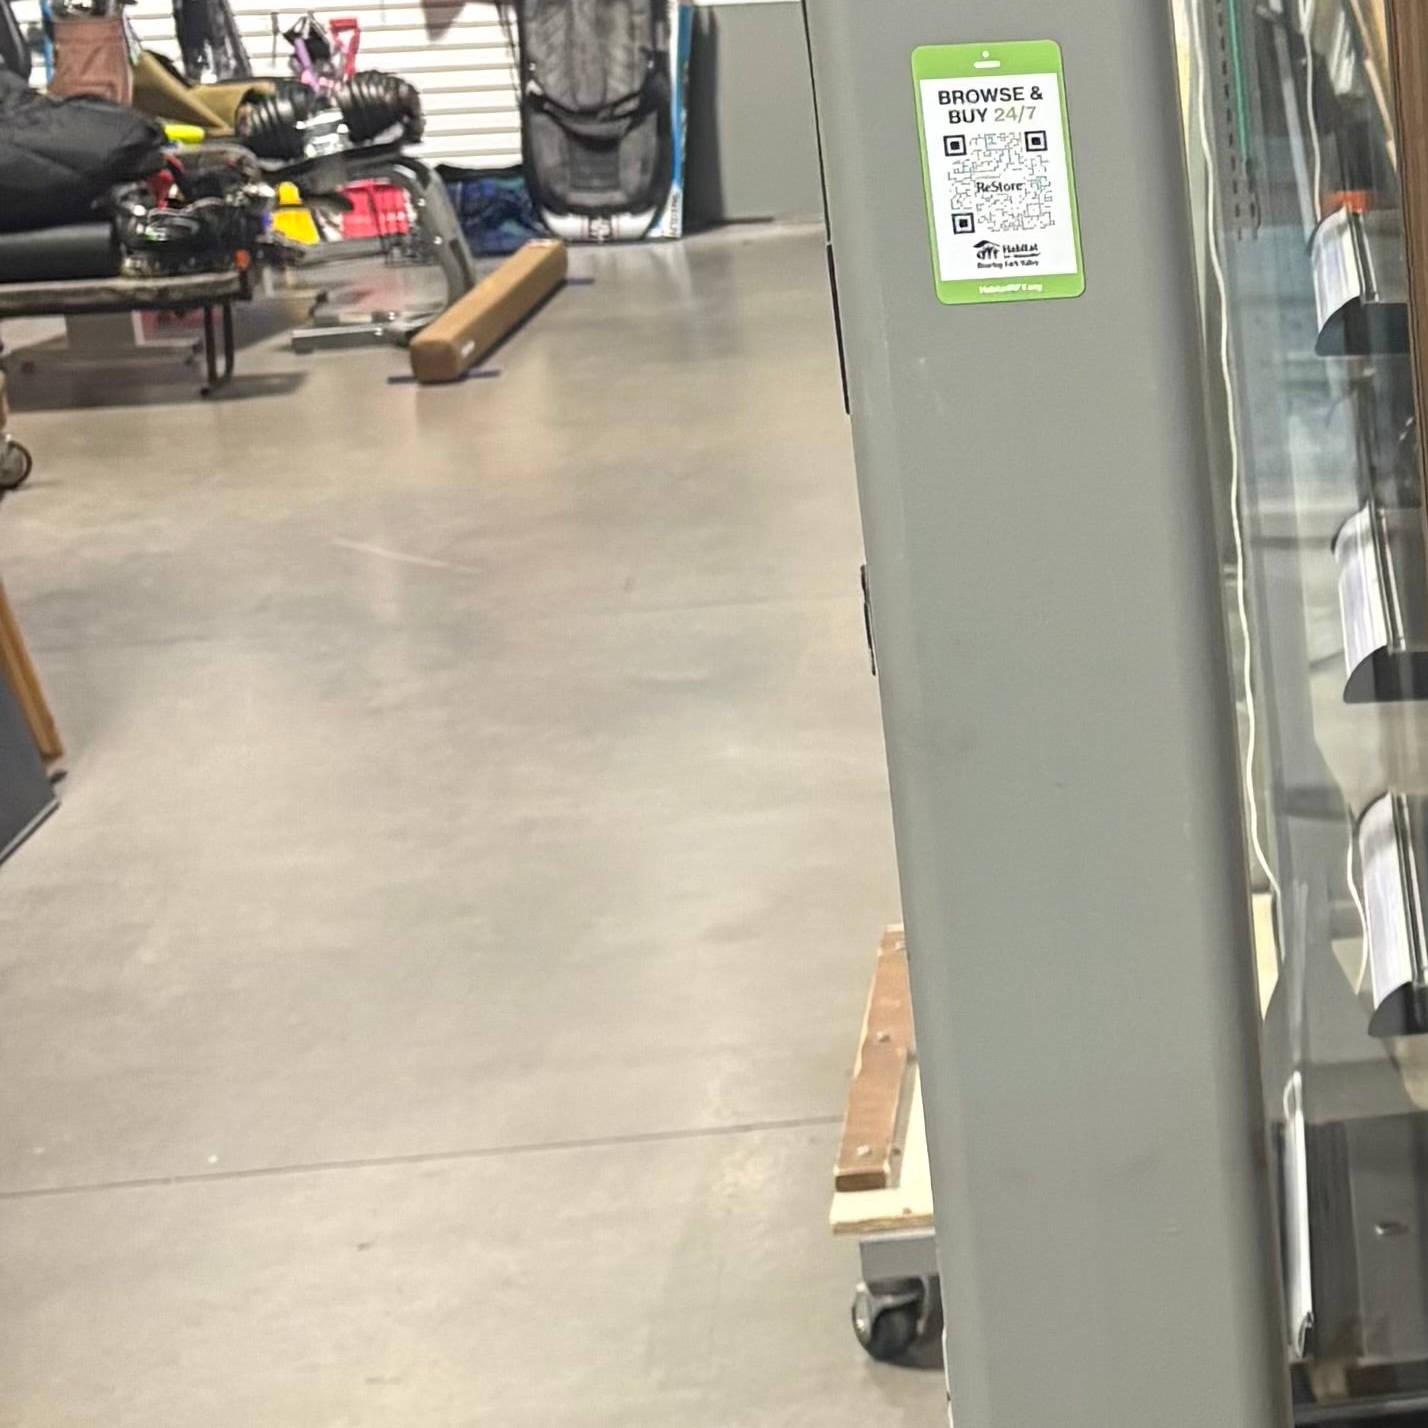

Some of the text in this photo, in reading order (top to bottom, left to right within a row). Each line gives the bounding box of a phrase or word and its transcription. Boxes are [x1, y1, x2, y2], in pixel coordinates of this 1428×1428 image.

[938, 85, 1043, 105] BROWSE &
[948, 105, 1036, 124] BUY 24/7
